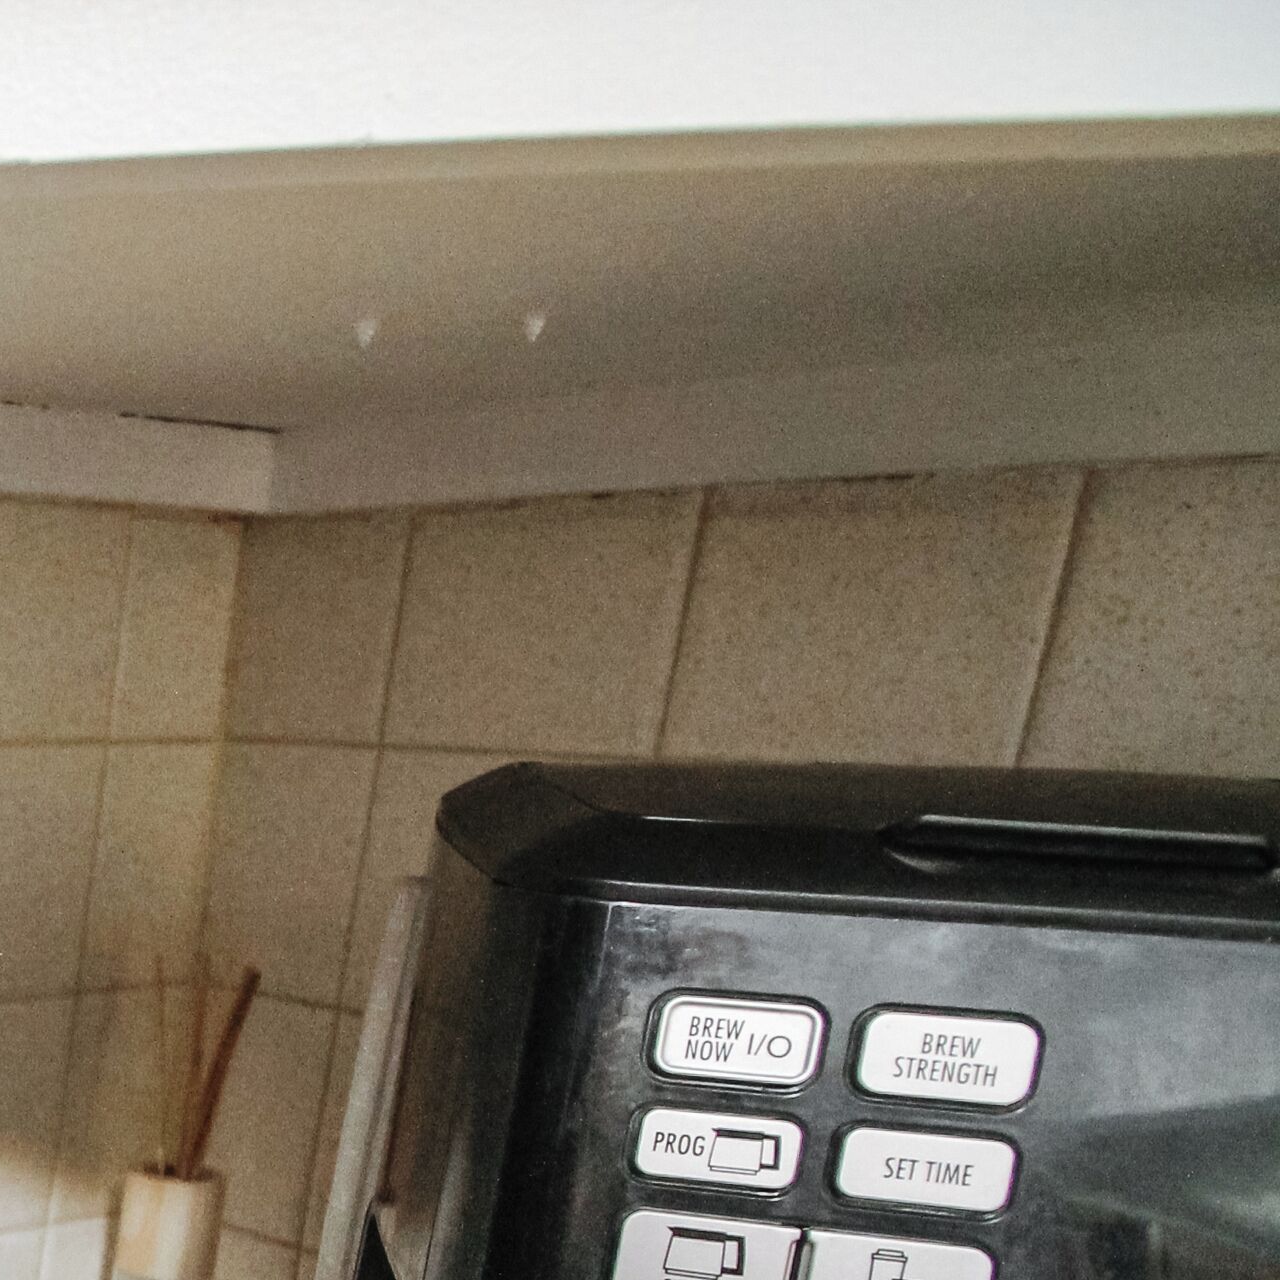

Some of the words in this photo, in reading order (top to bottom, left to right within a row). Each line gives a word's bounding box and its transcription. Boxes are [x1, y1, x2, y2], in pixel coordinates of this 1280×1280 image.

[688, 1015, 743, 1042] BREW
[683, 1038, 734, 1063] NOW
[920, 1032, 983, 1058] BREW
[892, 1055, 997, 1088] STRENGTH
[652, 1131, 706, 1157] PROG
[883, 1157, 917, 1182] SET
[925, 1161, 974, 1186] TIME
